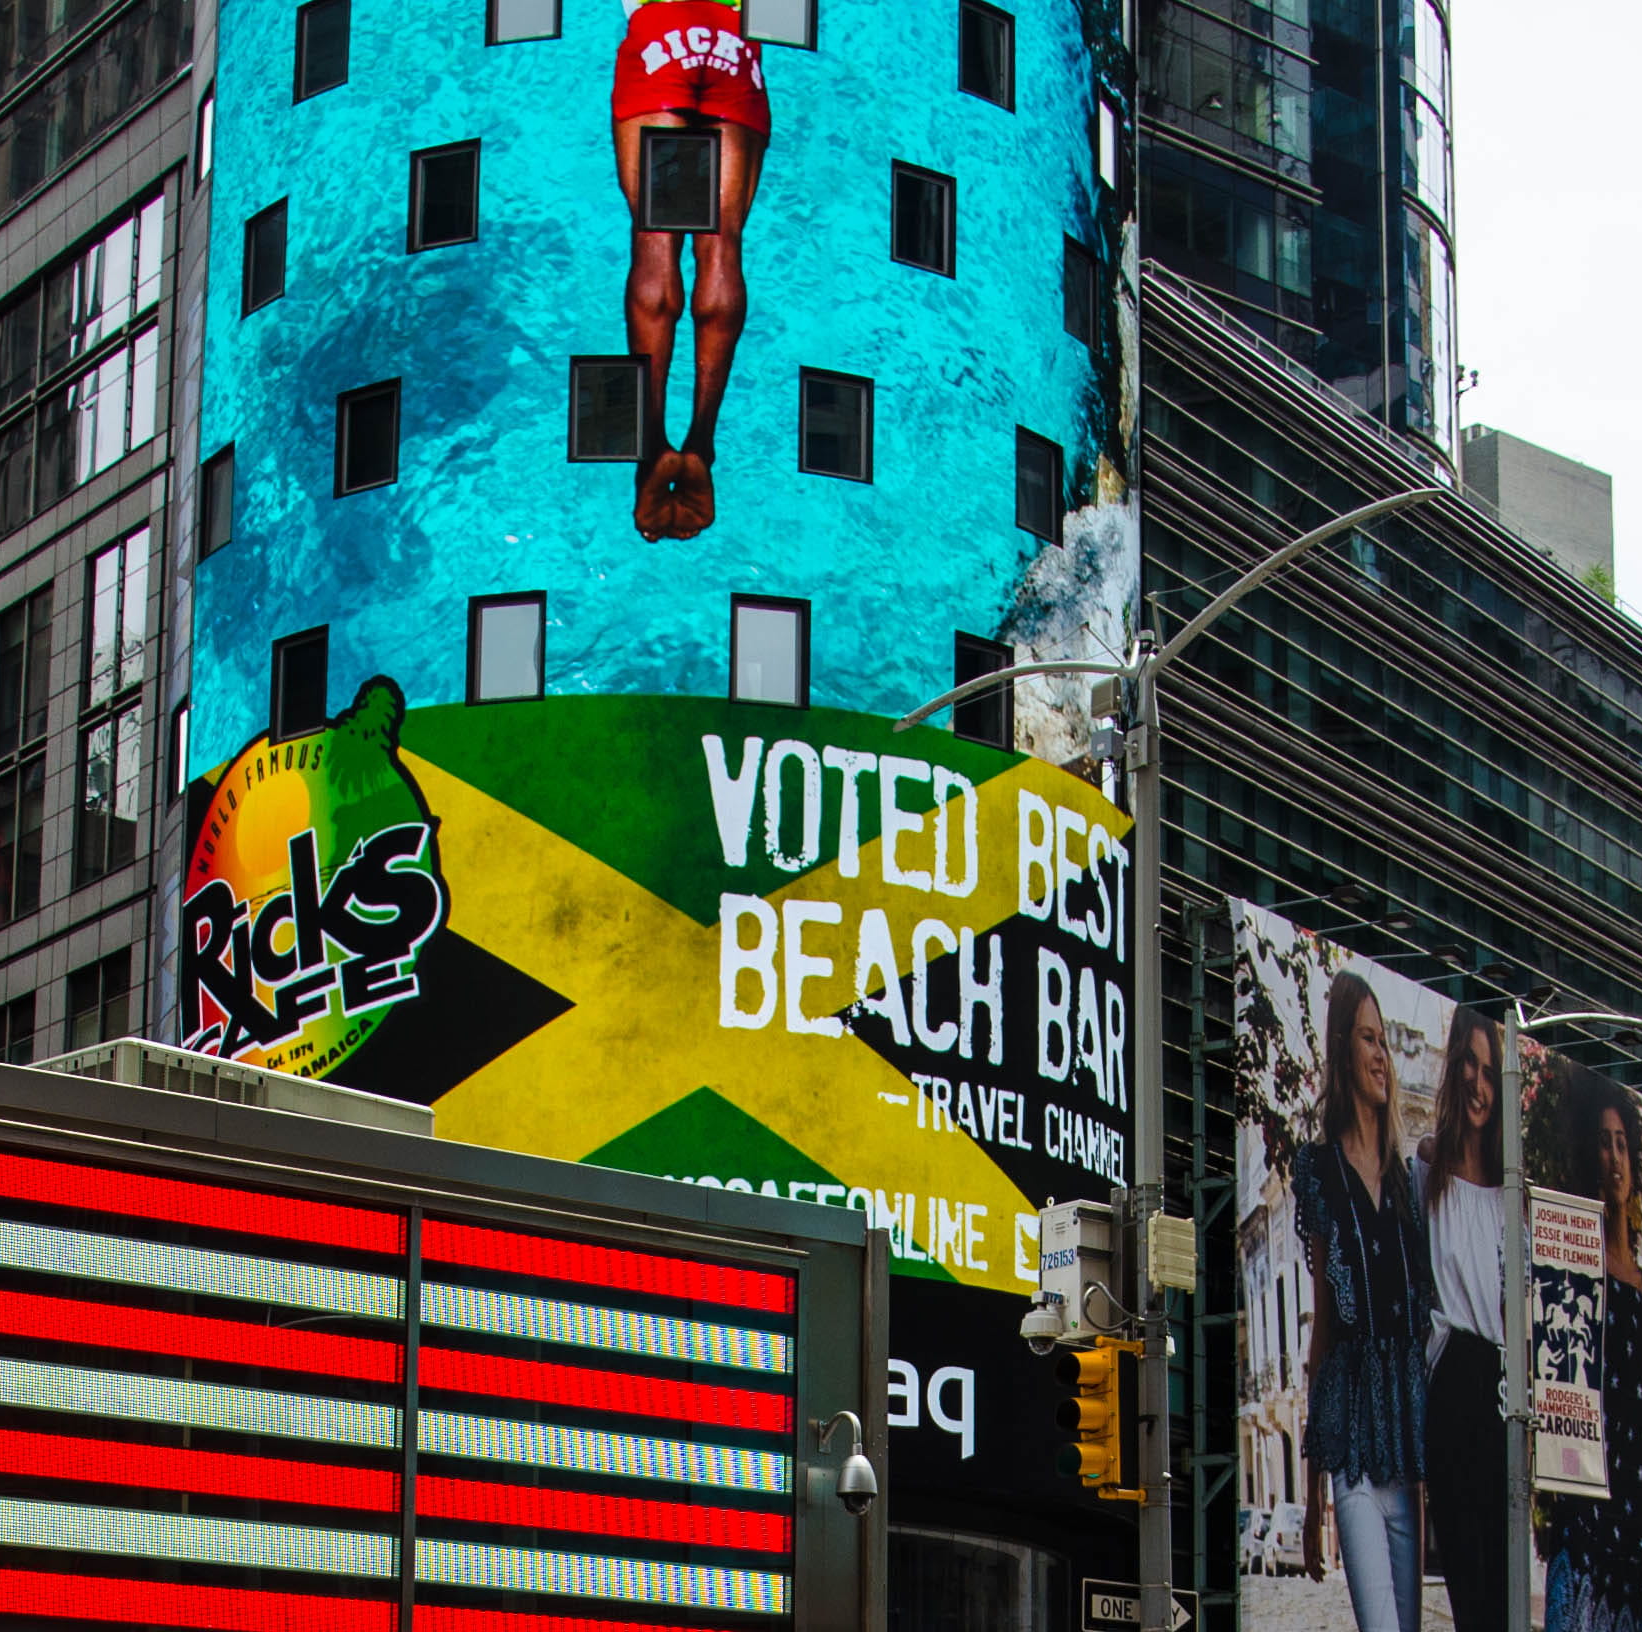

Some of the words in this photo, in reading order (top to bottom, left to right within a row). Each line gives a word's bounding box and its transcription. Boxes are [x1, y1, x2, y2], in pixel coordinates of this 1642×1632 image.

[245, 744, 324, 791] FAMOUS
[701, 734, 977, 898] VOTED
[1018, 788, 1129, 963] BEST
[719, 892, 1003, 1067] BEACH
[1038, 946, 1128, 1112] BAR
[1044, 1102, 1128, 1189] CHANNEL
[1536, 1208, 1567, 1226] JOSHUA
[1571, 1214, 1597, 1232] HENRY
[1534, 1226, 1561, 1242] JESSIE
[1563, 1231, 1601, 1250] MUELLER
[1042, 1248, 1074, 1271] 726153
[1563, 1249, 1599, 1267] FLEMING
[1546, 1388, 1583, 1406] RODGERS
[1537, 1400, 1599, 1421] HAMMERSTEIN'S
[1538, 1414, 1600, 1441] CAROUSEL
[1101, 1598, 1133, 1620] ONE
